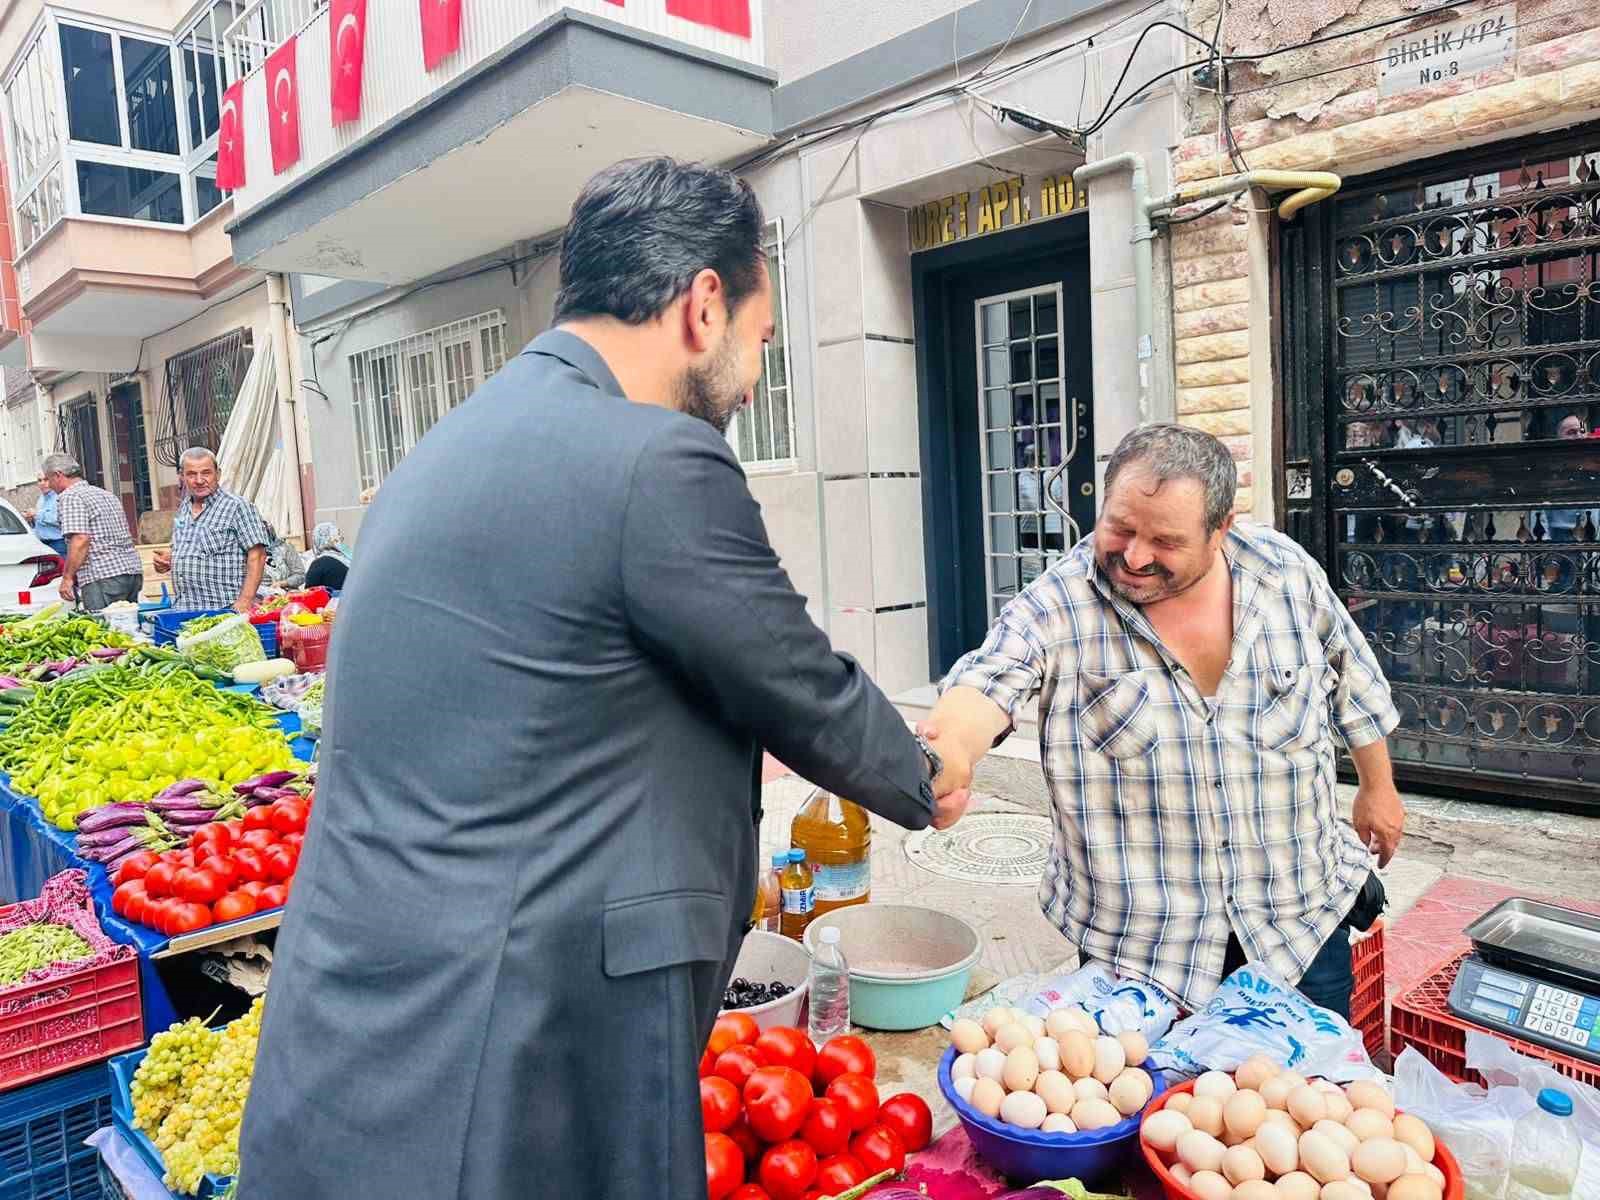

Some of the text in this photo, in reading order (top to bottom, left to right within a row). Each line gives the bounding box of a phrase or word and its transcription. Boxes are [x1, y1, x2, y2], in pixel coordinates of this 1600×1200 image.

[1388, 30, 1452, 68] BİRLİK
[1549, 1007, 1558, 1017] 5
[1544, 1022, 1554, 1032] 8
[1560, 1026, 1569, 1037] 9
[1576, 1032, 1585, 1042] 0
